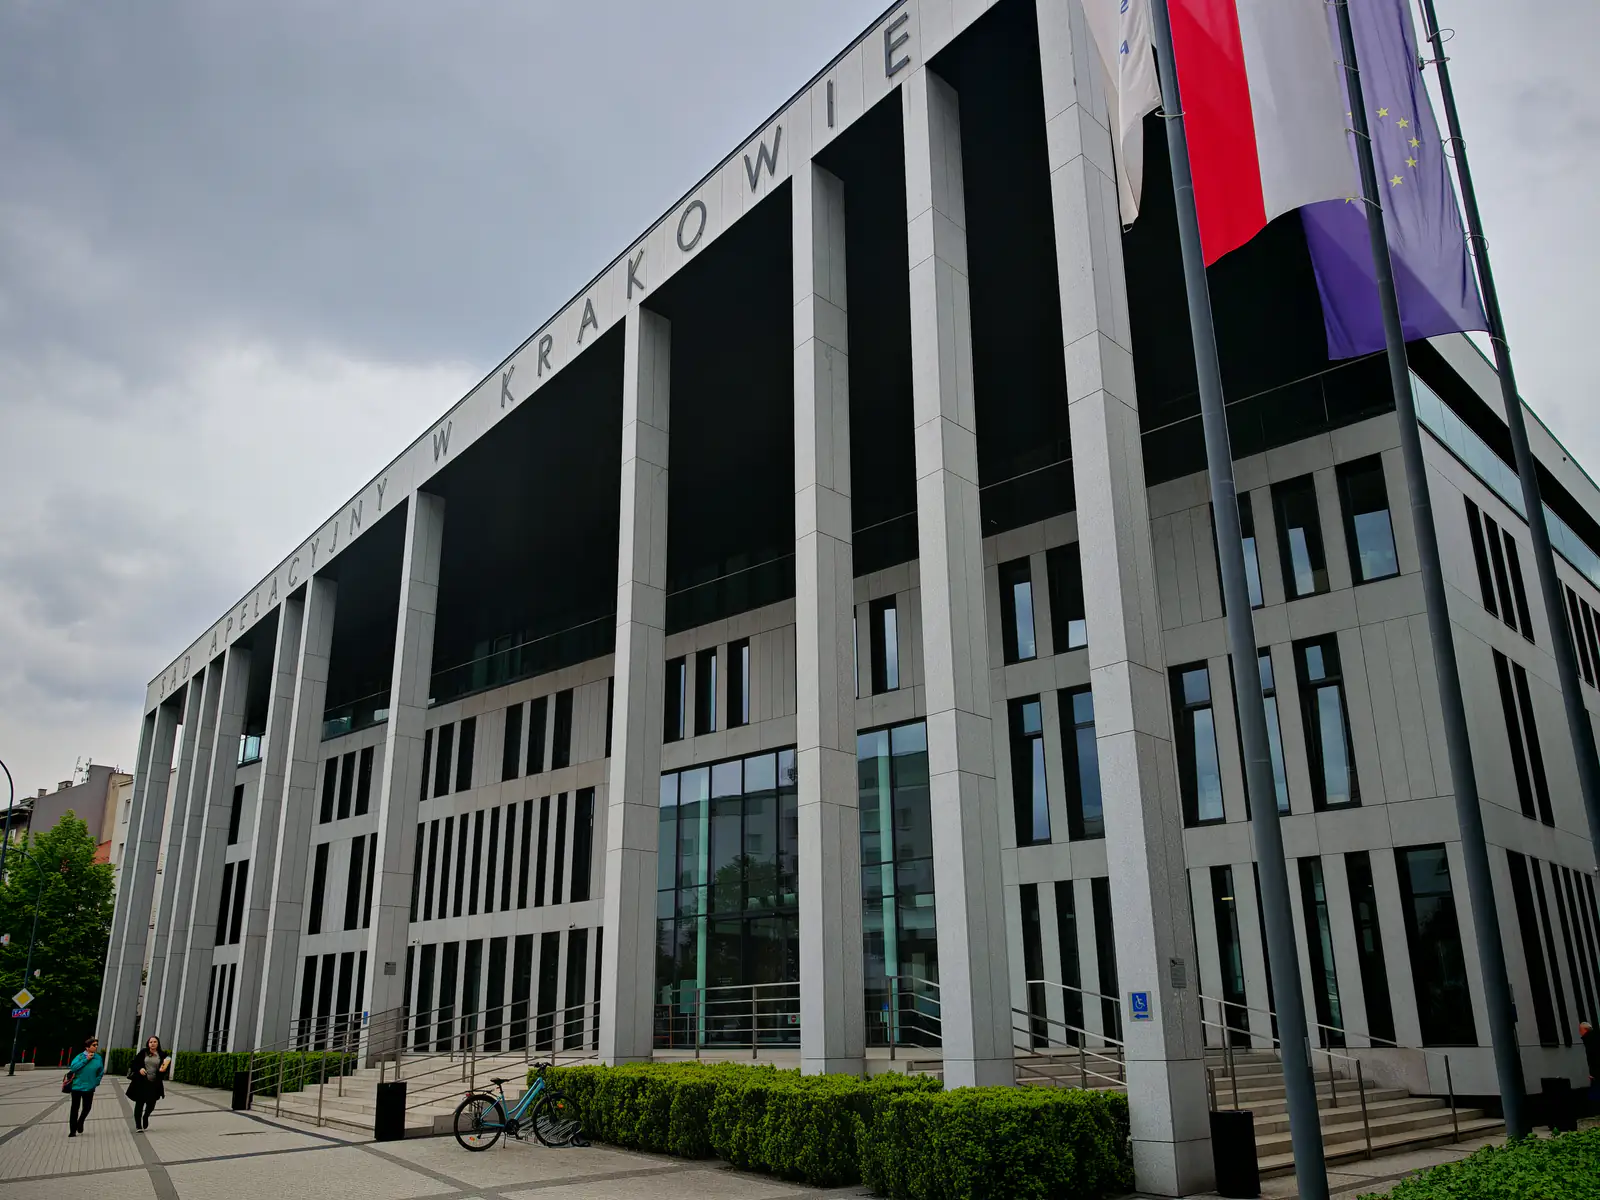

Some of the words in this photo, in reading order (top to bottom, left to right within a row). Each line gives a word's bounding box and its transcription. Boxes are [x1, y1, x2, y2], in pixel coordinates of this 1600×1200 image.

[209, 477, 388, 656] APELACYJNY
[432, 420, 452, 463] W
[500, 11, 910, 409] KRAKOWIE
